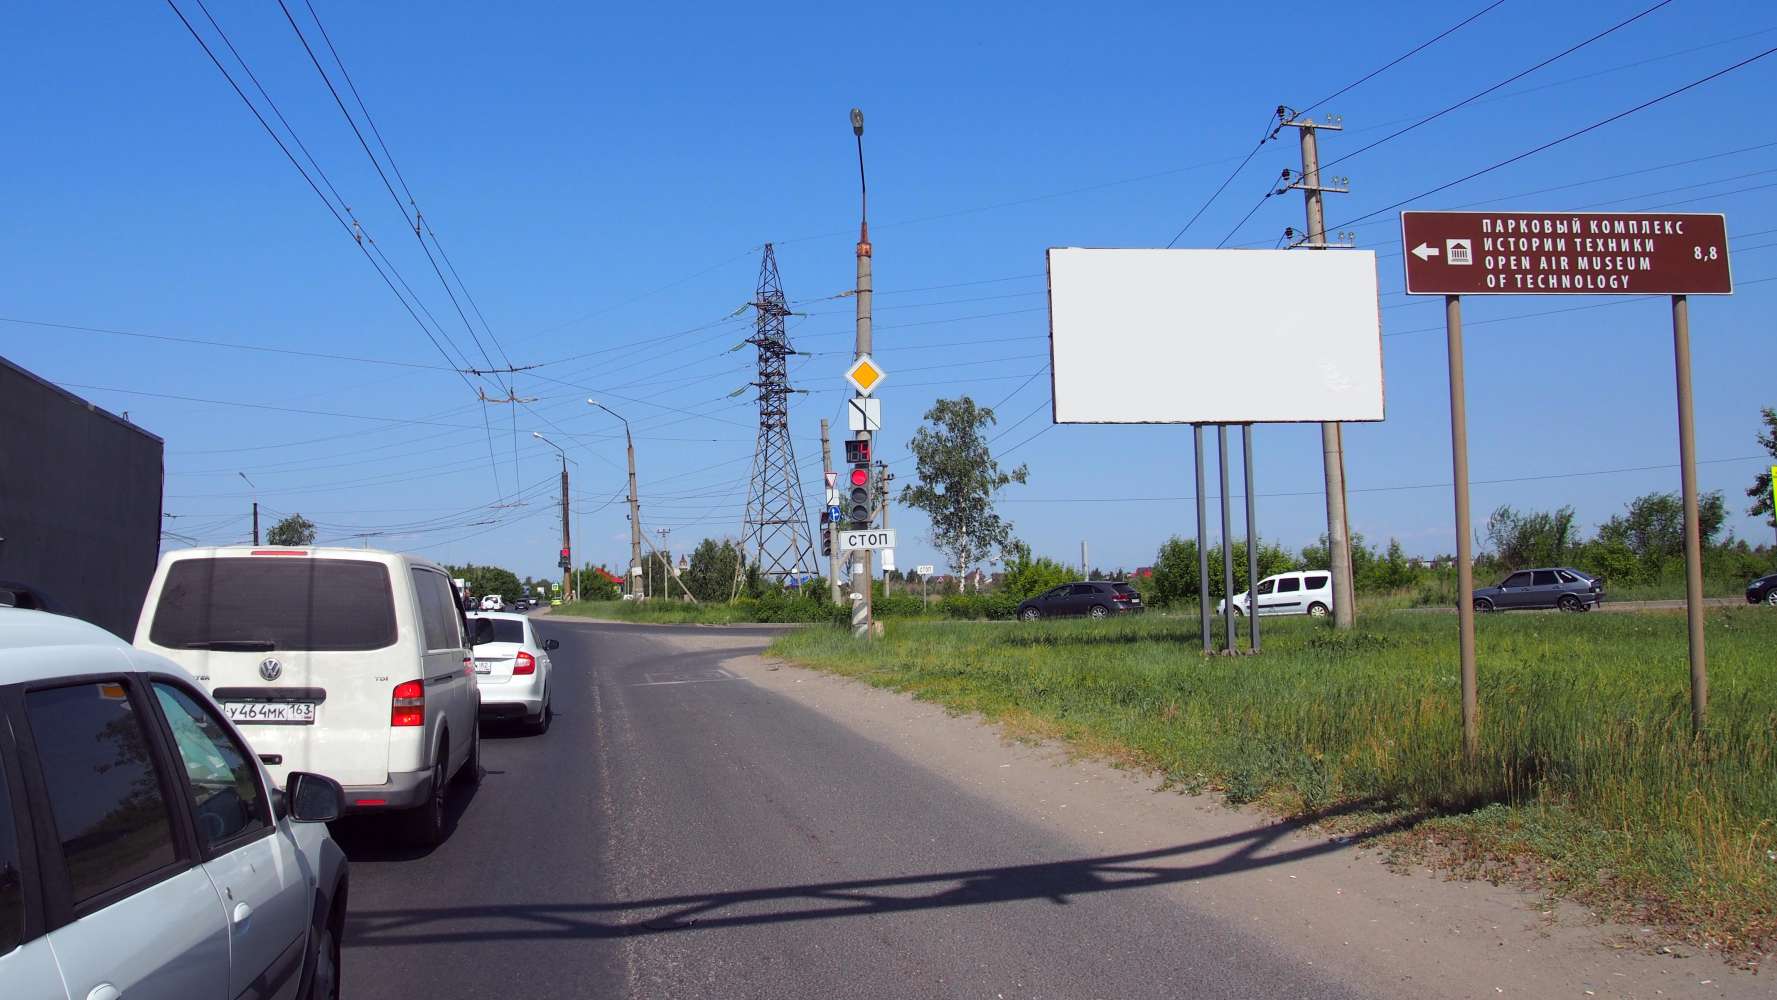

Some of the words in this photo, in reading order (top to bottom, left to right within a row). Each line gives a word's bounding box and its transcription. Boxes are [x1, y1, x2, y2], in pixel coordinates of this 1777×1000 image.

[1482, 218, 1581, 234] ПАРКОВЫЙ
[1590, 220, 1684, 235] КОМПЛЕКС
[1483, 238, 1566, 252] ИСТОРИИ
[1574, 238, 1654, 252] ТЕХНИКИ
[1693, 246, 1718, 262] 8,8
[1485, 256, 1530, 270] OPEN
[1539, 256, 1569, 270] AIR
[1577, 256, 1651, 270] MUSEUM
[1486, 274, 1506, 288] OF
[1515, 274, 1629, 289] TECHNOLOGY
[848, 533, 888, 546] СТОП
[289, 704, 310, 715] 163
